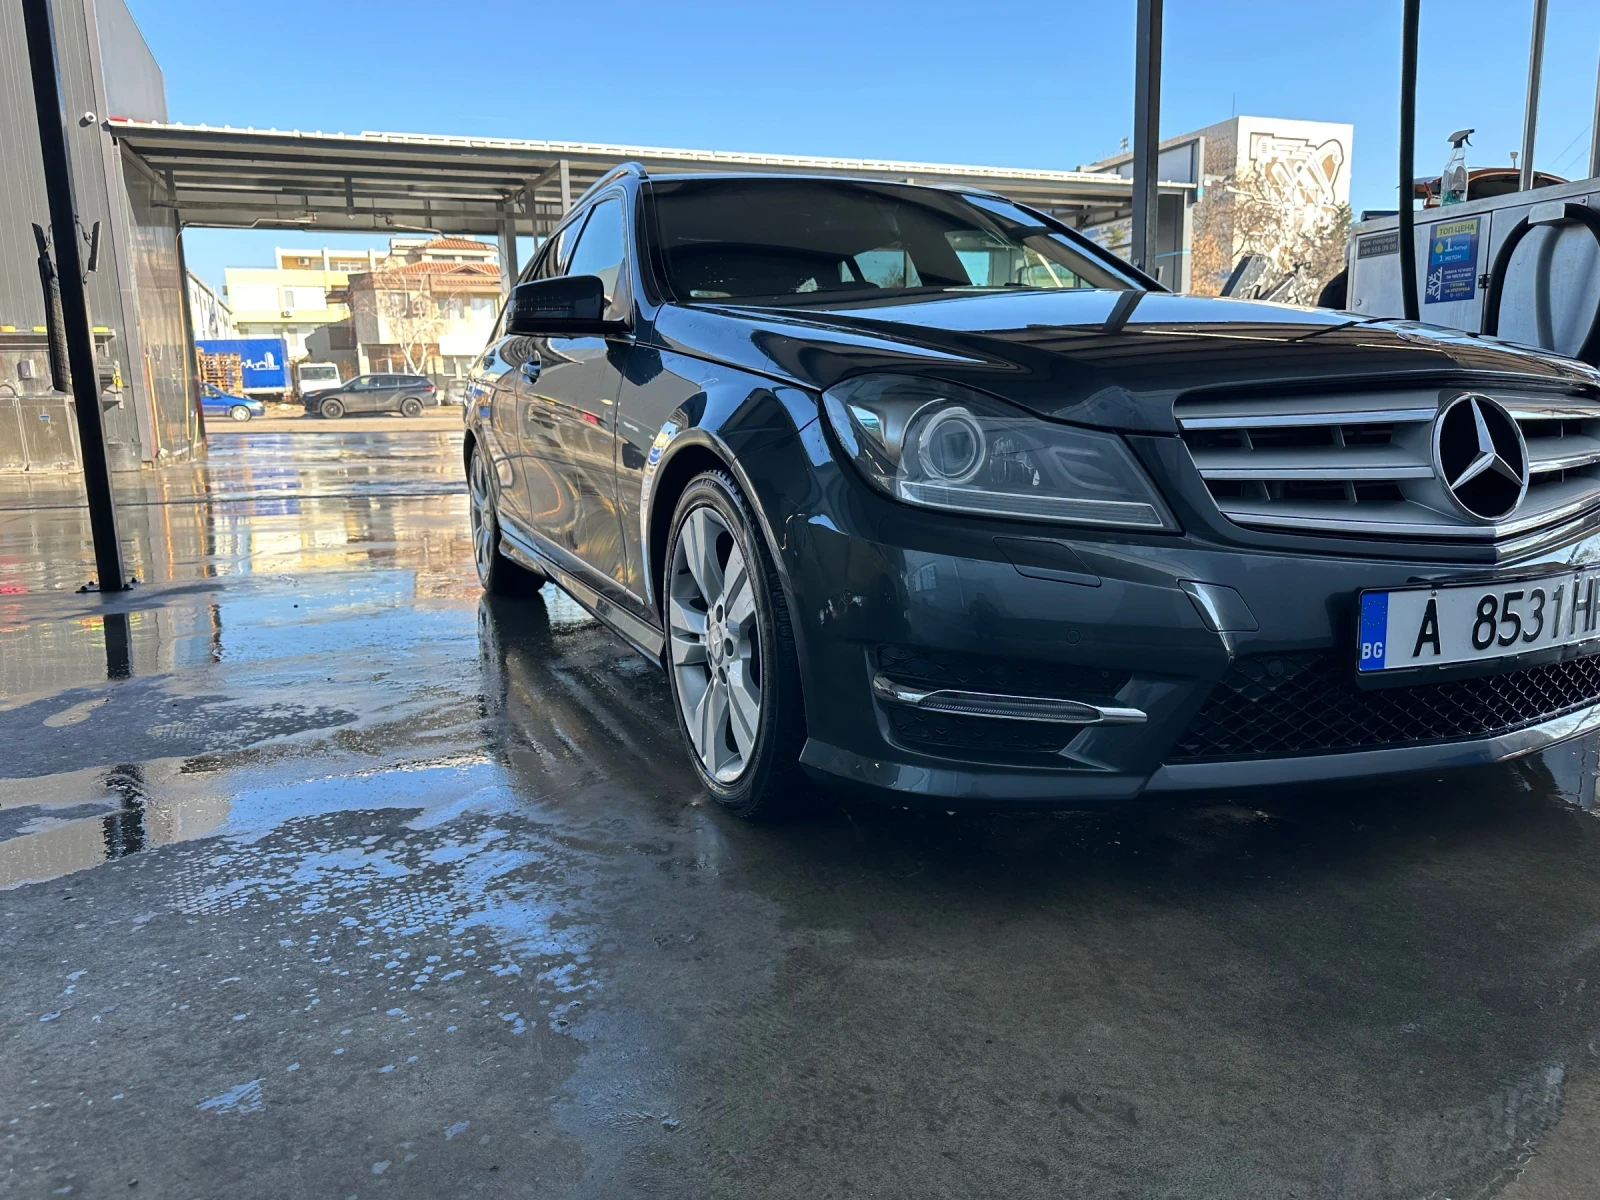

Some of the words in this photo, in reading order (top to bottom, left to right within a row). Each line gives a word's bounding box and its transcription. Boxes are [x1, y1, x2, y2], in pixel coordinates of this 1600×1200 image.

[1439, 226, 1453, 236] ТОП
[1455, 223, 1475, 234] ЦЕНА
[1444, 237, 1452, 253] 1
[1412, 598, 1441, 657] A
[1361, 641, 1383, 660] BG
